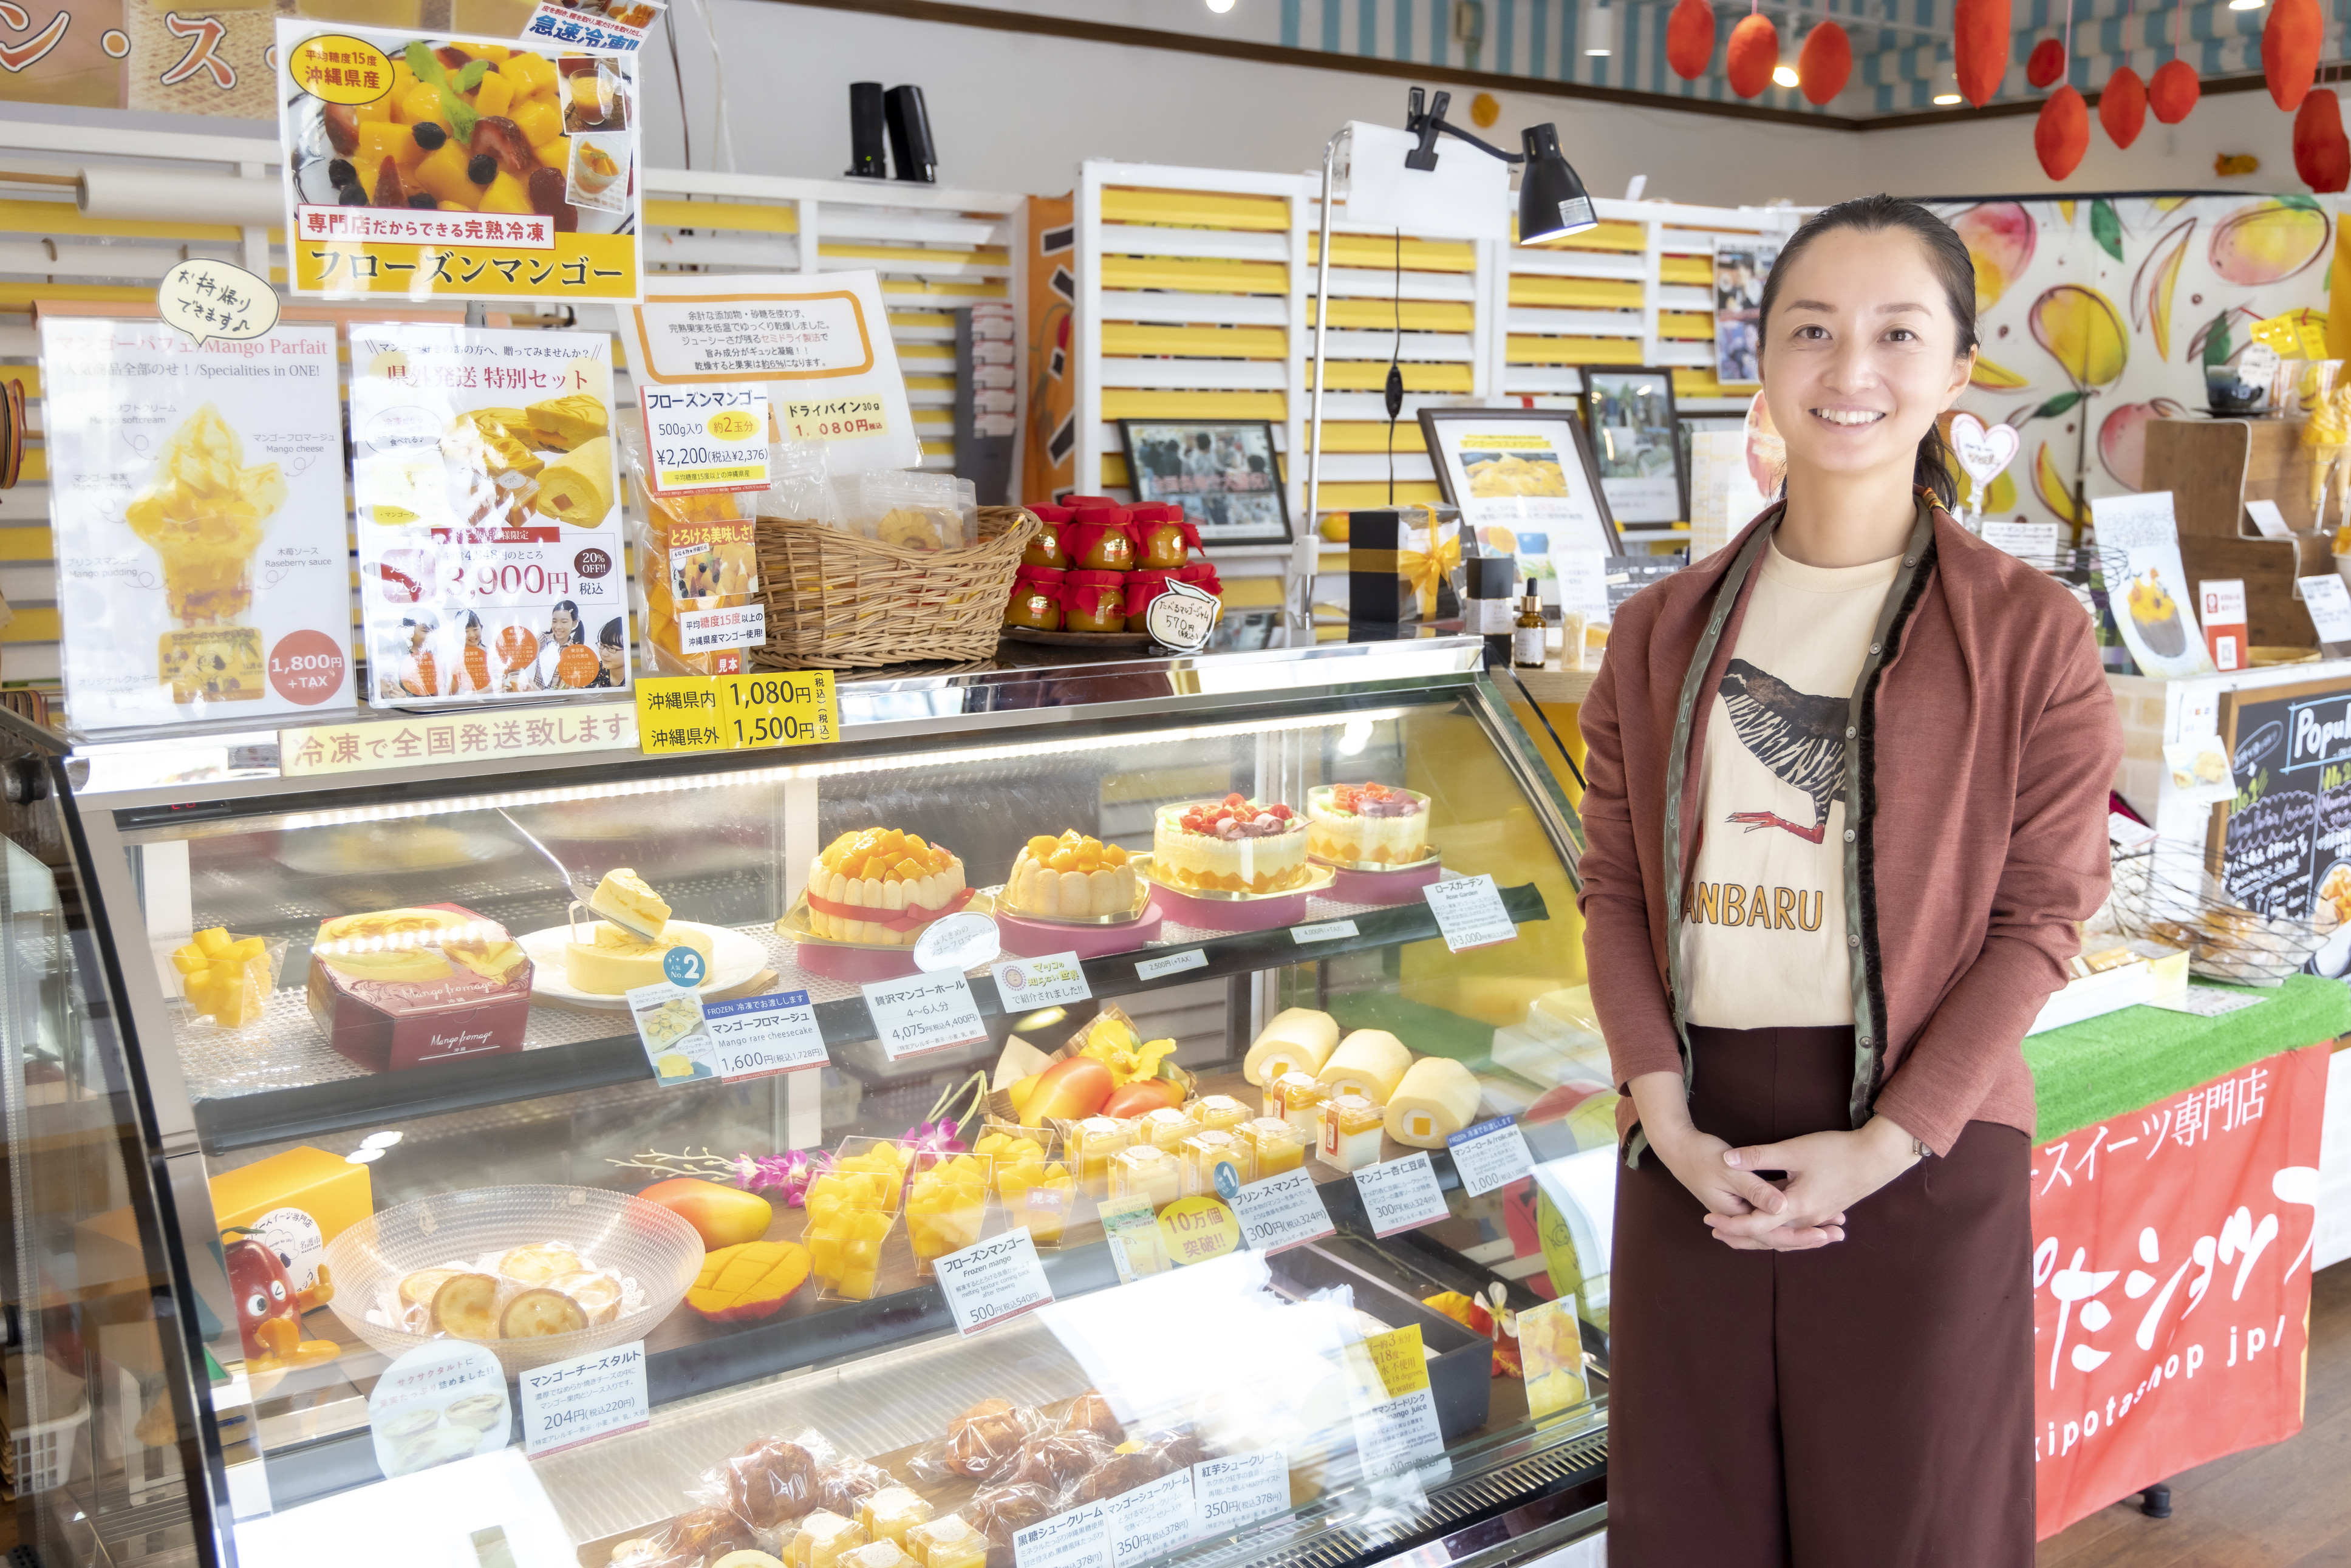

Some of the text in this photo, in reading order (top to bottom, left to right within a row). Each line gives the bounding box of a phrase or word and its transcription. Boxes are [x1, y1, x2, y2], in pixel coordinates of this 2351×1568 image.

[305, 49, 378, 67] 平均糖度15度
[305, 66, 381, 90] 沖縄県産
[307, 212, 545, 242] 専門店だからできる完熟冷凍
[311, 250, 624, 286] フローズンマンゴー
[178, 268, 250, 313] お持帰り
[688, 309, 805, 321] 余計な添加物・砂糖を使わず、
[669, 320, 830, 333] 完熟果実を低温でゆっくり乾燥しました。
[270, 338, 329, 355] Parfait
[681, 332, 828, 346] ジューシーさが残るセミドライ製法で
[274, 364, 286, 377] in
[289, 364, 321, 377] ONE!
[484, 366, 588, 390] 特別セット
[647, 390, 768, 409] フローズンマンゴー
[122, 415, 166, 424] softcream
[658, 416, 754, 438] 500g入り 約2玉分
[253, 433, 336, 443] マンゴーフロマージュ
[266, 444, 325, 454] Mango cheese
[73, 473, 128, 483] マンゴー果実
[674, 470, 751, 482] 平均糖度15度以上の沖縄県産
[670, 525, 753, 547] とろける美味しさ!
[265, 557, 332, 568] Raseberry sauce
[277, 547, 319, 557] 木苺ソース
[582, 553, 605, 564] 20%
[69, 567, 138, 580] Mango pudding
[582, 564, 606, 574] OFF!!
[446, 564, 568, 599] 3,900円
[579, 582, 604, 595] 税込
[686, 613, 763, 630] 平均糖度15度以上の
[1165, 615, 1195, 633] 570円
[689, 629, 763, 647] 沖縄県産マンゴー使用!
[271, 653, 343, 672] 1,800円
[718, 658, 739, 673] 見本
[288, 675, 328, 689] +TAX
[647, 690, 716, 711] 沖縄県内
[729, 680, 811, 710] 1,080円
[293, 712, 630, 768] 冷凍で全国発送致します
[651, 726, 720, 748] 沖縄県外
[734, 716, 815, 745] 1,500円
[1436, 878, 1484, 893] ローズガーデン
[1682, 882, 1823, 932] ANBARU
[1032, 961, 1065, 973] マツコの
[1028, 970, 1080, 987] 知らない世界
[401, 980, 494, 1001] Mango fromage
[875, 980, 965, 1006] 贅沢マンゴーホール
[1012, 986, 1084, 1005] で紹介されました!!
[708, 994, 804, 1015] FROZEN 冷凍でお渡しします
[712, 1012, 810, 1034] マンゴーフロマージュ
[892, 1014, 978, 1041] 4,075円(税込4,400円)
[431, 1030, 494, 1049] Mango fromage
[718, 1038, 747, 1048] Mango
[768, 1027, 813, 1040] cheesecake
[722, 1048, 824, 1072] 1,600円(税込1,728円)
[1448, 1133, 1467, 1144] FROZEN
[2032, 1068, 2268, 1197] スイーツ専門店
[1357, 1158, 1427, 1185] マンゴー杏仁豆腐
[1031, 1191, 1060, 1205] 見本
[1240, 1188, 1312, 1216] まるで本物のマンゴーを食べている
[1375, 1193, 1437, 1218] 300円(税込324円)
[1165, 1206, 1224, 1235] 10万個
[1247, 1209, 1327, 1241] 300円(税込324円)
[300, 1235, 321, 1250] 名護市
[1182, 1232, 1227, 1260] 突破!!
[944, 1237, 1025, 1273] フローズンマンゴー
[963, 1255, 1012, 1277] Frozen mango
[961, 1287, 980, 1298] melting
[981, 1280, 999, 1291] texture
[1000, 1273, 1018, 1283] coming
[982, 1282, 1015, 1298] after thawing
[970, 1291, 1040, 1323] 500円(税込540円)
[397, 1357, 474, 1386] サクサクタルトに
[530, 1350, 641, 1388] マンゴーチーズタルト
[535, 1367, 636, 1401] 濃厚でなめらか焼きチーズの中に
[540, 1379, 634, 1410] マンゴー果肉とソース入りです。
[544, 1397, 635, 1430] 204円(税込220円)
[1411, 1403, 1427, 1415] juice
[1202, 1451, 1283, 1478] 紅芋シュークリーム
[1108, 1474, 1190, 1514] マンゴーシュークリーム
[1204, 1491, 1283, 1518] 350円(税込378円)
[1018, 1507, 1104, 1547] 黒糖シュークリーム
[1020, 1519, 1104, 1557] ミネラルたっぷり沖縄黒糖使用
[1117, 1518, 1189, 1556] 350円(税込378円)
